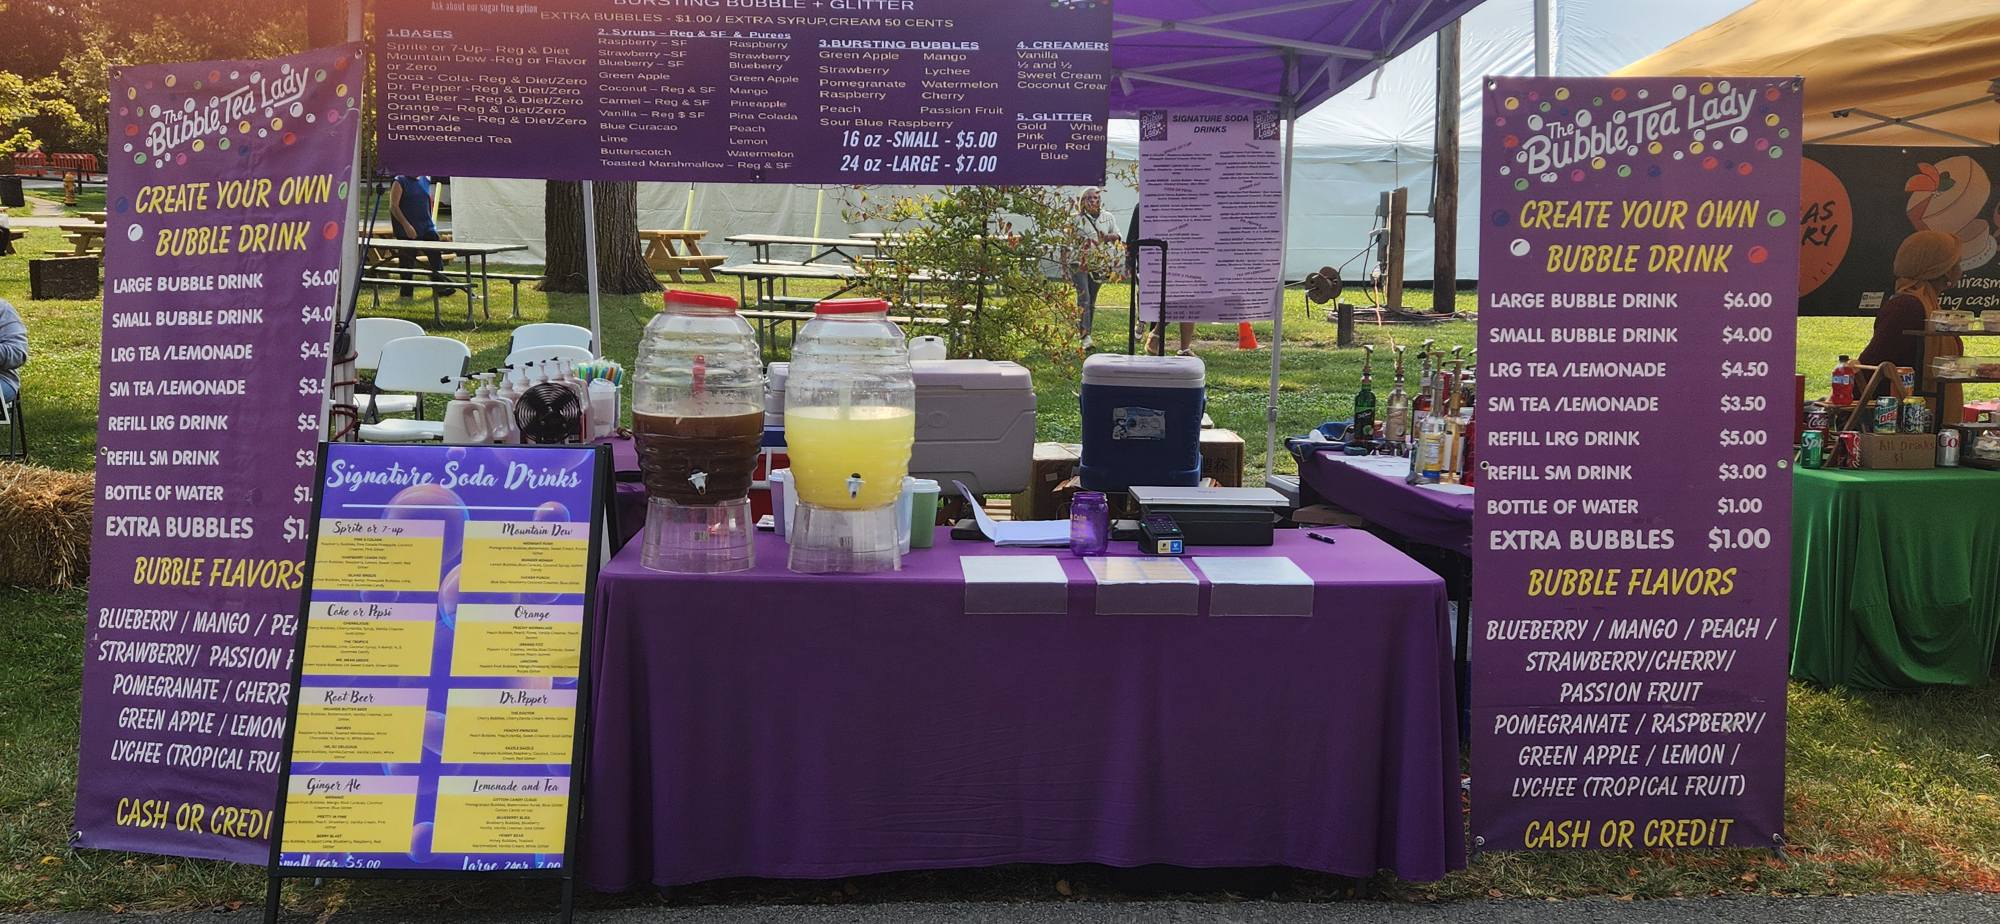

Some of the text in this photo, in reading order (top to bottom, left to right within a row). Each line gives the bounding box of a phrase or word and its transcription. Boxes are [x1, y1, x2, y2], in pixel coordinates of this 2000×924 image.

[540, 11, 954, 27] EXTRA BUBBLES $1.00 EXTRA SYRUP,CREAM 50 CENTS
[386, 29, 453, 38] 1.BASES
[818, 40, 979, 50] 3.BURSTING BUBBLES
[819, 51, 899, 61] Green Apple
[923, 53, 967, 61] Mango
[819, 66, 890, 75] Strawberry
[925, 68, 970, 76] Lychee
[820, 79, 906, 88] Pomegranate
[922, 81, 998, 89] Watermelon
[820, 91, 886, 100] Raspberry
[922, 92, 965, 101] Cherry
[150, 67, 309, 156] The Bubble Tea Lady
[820, 105, 861, 113] Peach
[1016, 113, 1092, 121] 5. GLITTER
[388, 124, 461, 132] Lemonade
[855, 119, 883, 127] Blue
[888, 119, 953, 128] Raspberry
[1017, 122, 1103, 131] Gold White
[1522, 88, 1757, 175] The Bubble Tea Lady
[388, 133, 512, 144] Unsweetened Tea
[842, 130, 997, 150] 16 oz -SMALL $5.00
[840, 154, 997, 174] 24 oz -LARGE $7.00
[135, 174, 333, 214] CREATE YOUR OWN
[1520, 199, 1760, 229] CREATE YOUR OWN
[155, 221, 311, 257] BUBBLE DRINK
[1547, 244, 1733, 274] BUBBLE DRINK
[114, 276, 152, 294] LARGE
[157, 275, 213, 291] BUBBLE
[218, 273, 263, 290] DRINK
[1491, 292, 1772, 310] LARGE BUBBLE DRINK $6.00
[1966, 295, 1999, 307] cash
[1490, 326, 1772, 344] SMALL BUBBLE DRINK $4.00
[111, 344, 253, 362] LRG TEA /LEMONADE
[1490, 361, 1768, 379] LRG TEA /LEMONADE $4.50
[1488, 394, 1766, 413] SM TEA /LEMONADE $3.50
[1488, 429, 1767, 447] REFILL LRG DRINK $5.00
[327, 459, 582, 492] Signature Soda Drinks
[1487, 463, 1767, 482] REFILL SM DRINK $3.00
[1487, 497, 1762, 515] BOTTLE OF WATER $1.00
[106, 516, 254, 539] EXTRA BUBBLES
[332, 522, 403, 536] Sprite or 7-up
[502, 522, 572, 536] Mountain Dew
[1490, 526, 1771, 552] EXTRA BUBBLES $1.00
[1528, 567, 1737, 596] BUBBLE FLAVORS
[328, 604, 392, 618] Coke or Pepsi
[514, 606, 549, 621] Orange
[1486, 618, 1760, 641] BLUEBERRY MANGO PEACH
[1526, 650, 1736, 672] STRAWBERRY/CHERRY/
[324, 691, 375, 703] Root Beer
[1560, 681, 1703, 703] PASSION FRUIT
[1494, 712, 1766, 735] POMEGRANATE RASPBERRY/
[1519, 744, 1726, 767] GREEN APPLE LEMON
[307, 778, 360, 794] Ginger Ale
[473, 778, 559, 792] Lemonade and Tea
[1512, 775, 1746, 797] LYCHEE (TROPICAL FRUIT)
[1524, 818, 1734, 849] CASH OR CREDIT
